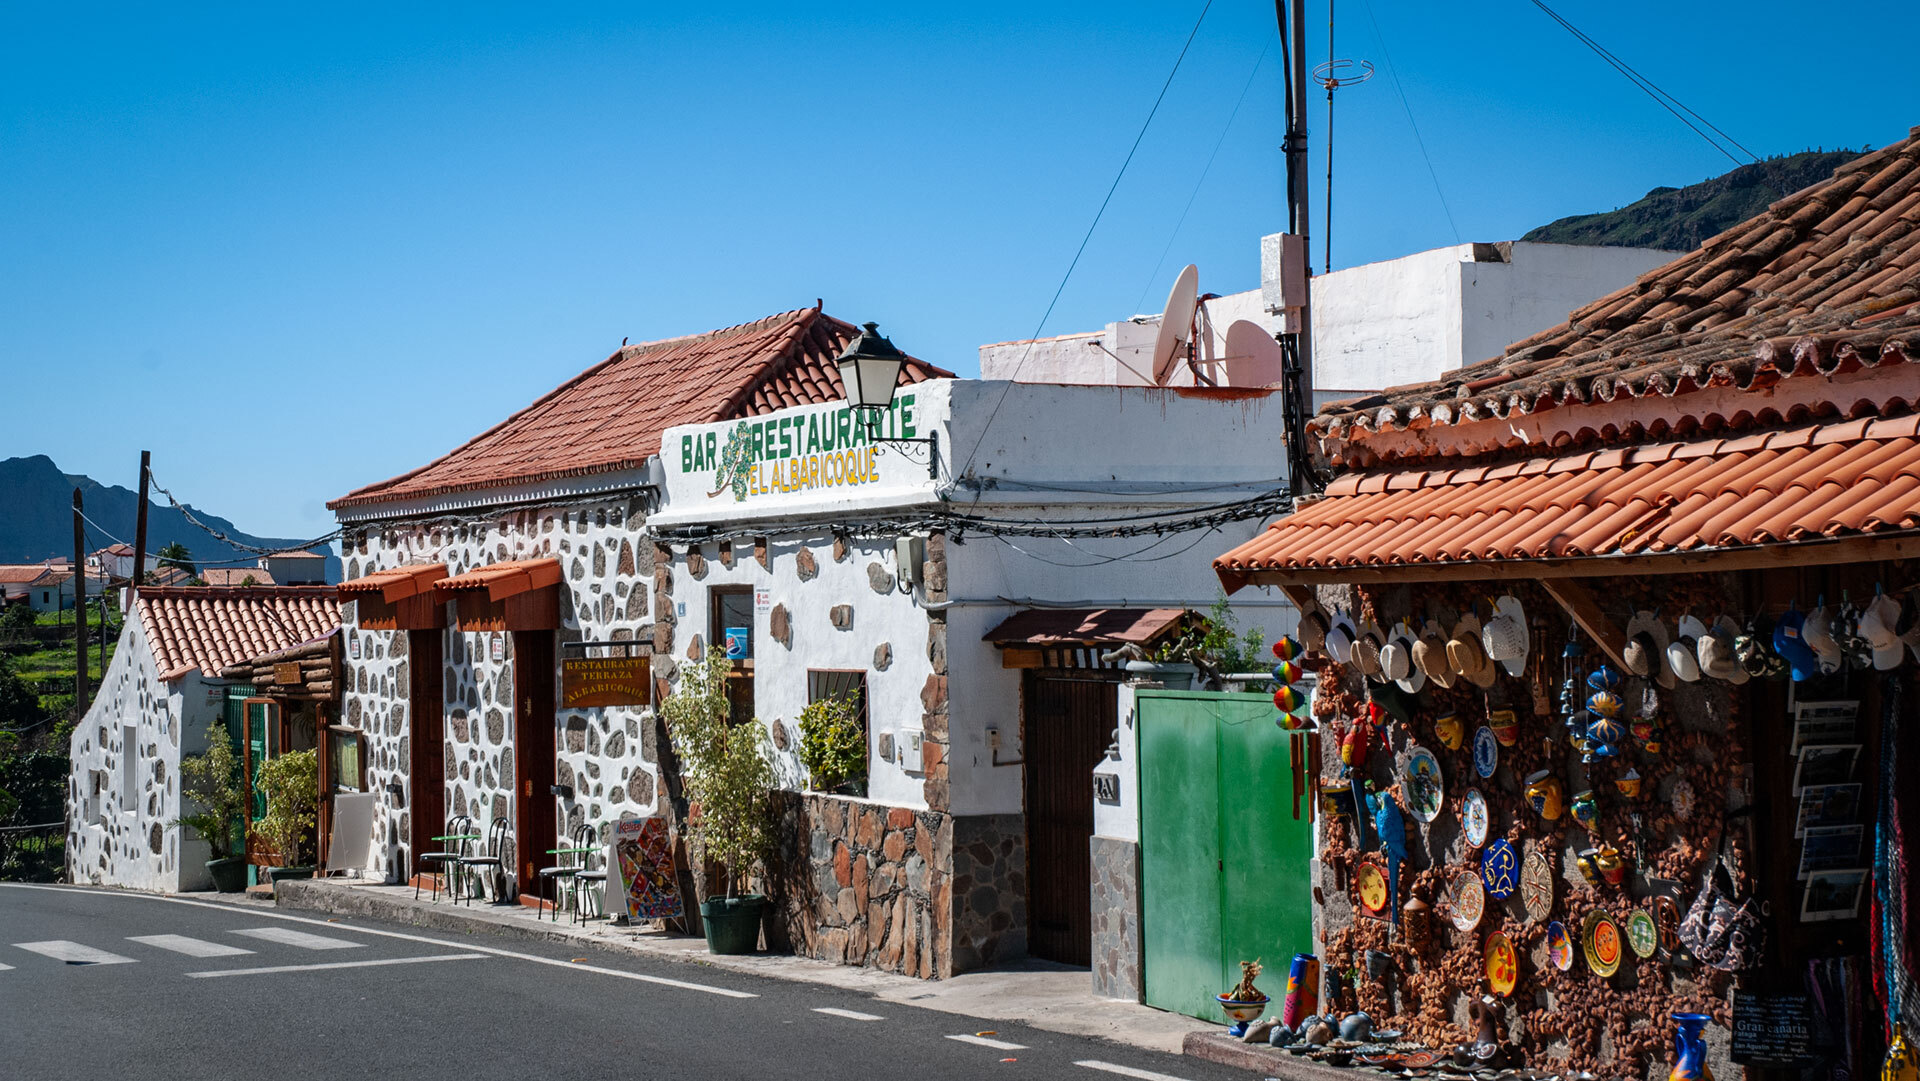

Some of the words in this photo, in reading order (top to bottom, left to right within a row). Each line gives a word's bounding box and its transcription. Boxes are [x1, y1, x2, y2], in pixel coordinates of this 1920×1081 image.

[682, 431, 717, 473] BAR
[751, 394, 917, 463] RESTAURANTE
[750, 463, 768, 496] EL
[770, 446, 880, 494] ALBARICOQUE
[566, 659, 648, 671] RESTAURANTE
[581, 671, 633, 681] TERRAZA
[568, 683, 646, 704] ALBARICOQUE
[1736, 1020, 1765, 1031] Gran
[1767, 1023, 1808, 1034] canaria
